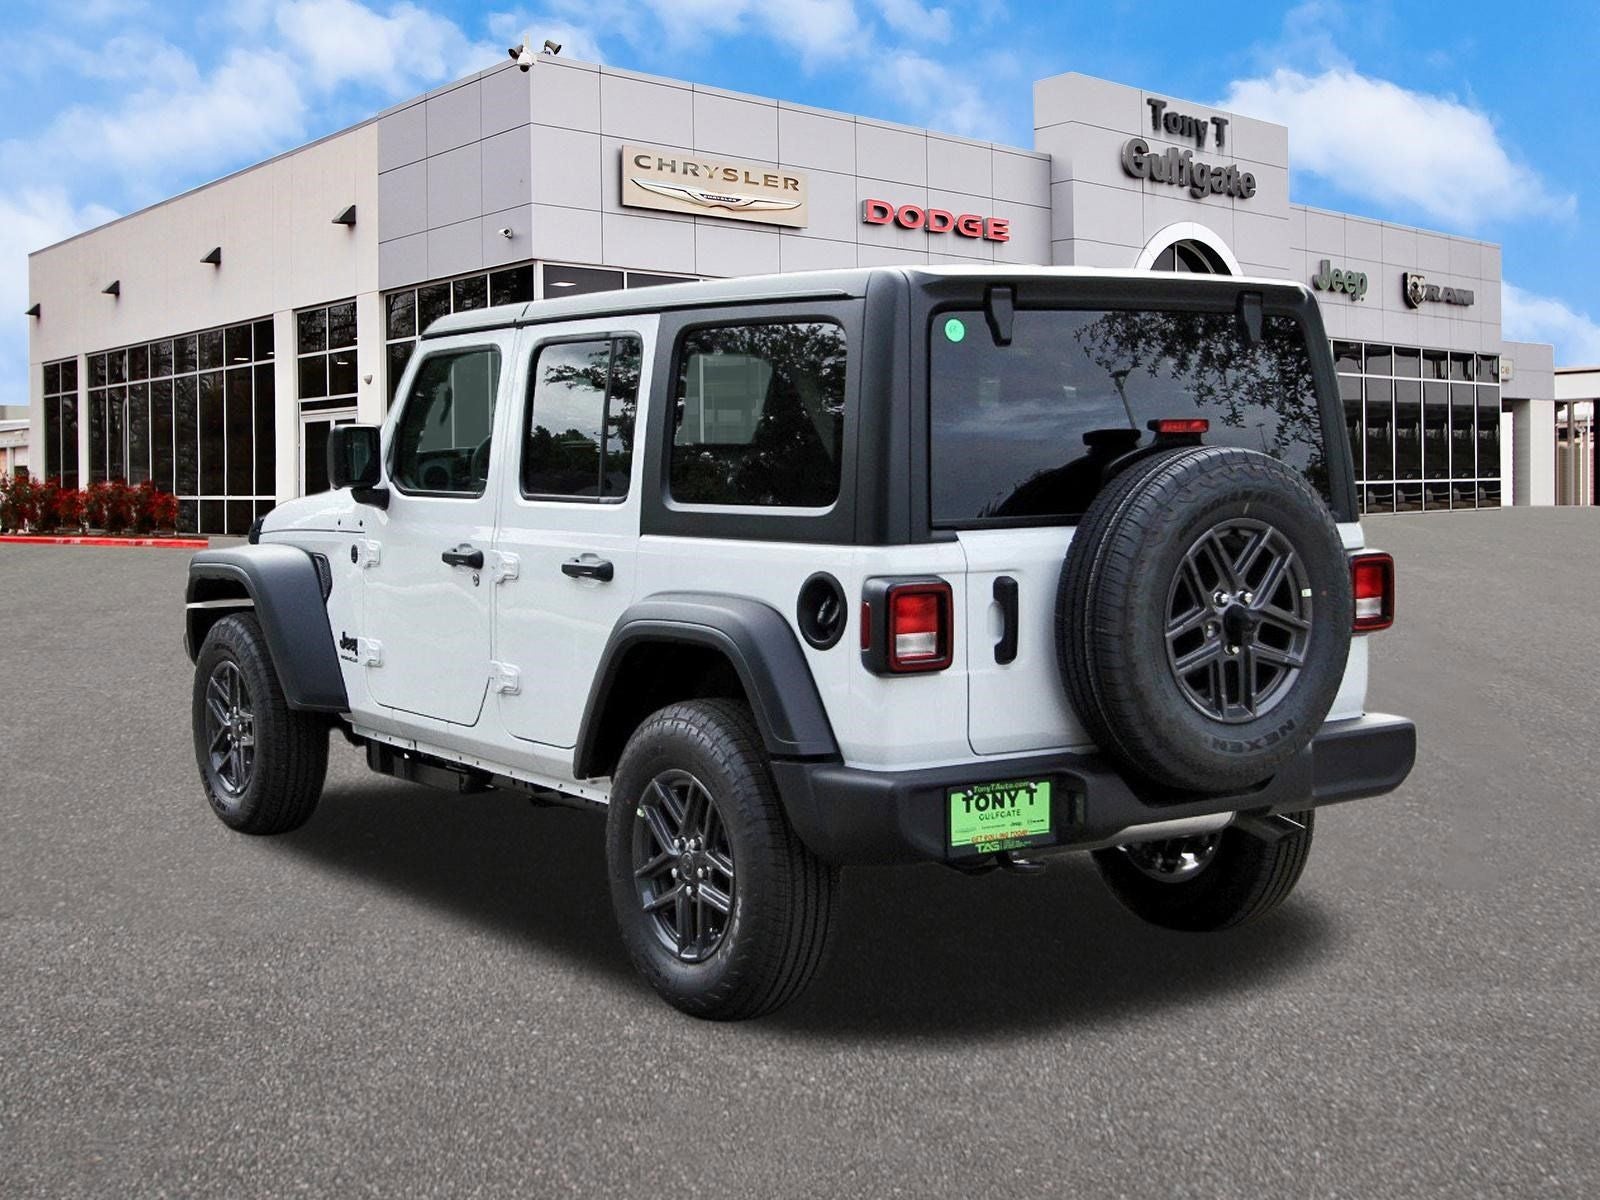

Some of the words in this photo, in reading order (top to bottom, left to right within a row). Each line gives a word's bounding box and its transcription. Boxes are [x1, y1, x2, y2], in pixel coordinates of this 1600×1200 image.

[1147, 98, 1208, 147] Tony
[1210, 116, 1229, 147] T
[633, 154, 800, 192] CHRYSLER
[1121, 138, 1256, 199] Gulfgate
[863, 198, 1010, 242] DODGE
[1313, 259, 1368, 302] Jeep
[1425, 284, 1475, 307] RAM
[1212, 719, 1296, 753] NEXEN
[962, 789, 1020, 813] TONY
[1026, 787, 1037, 805] T
[979, 809, 1022, 821] GULFGATE
